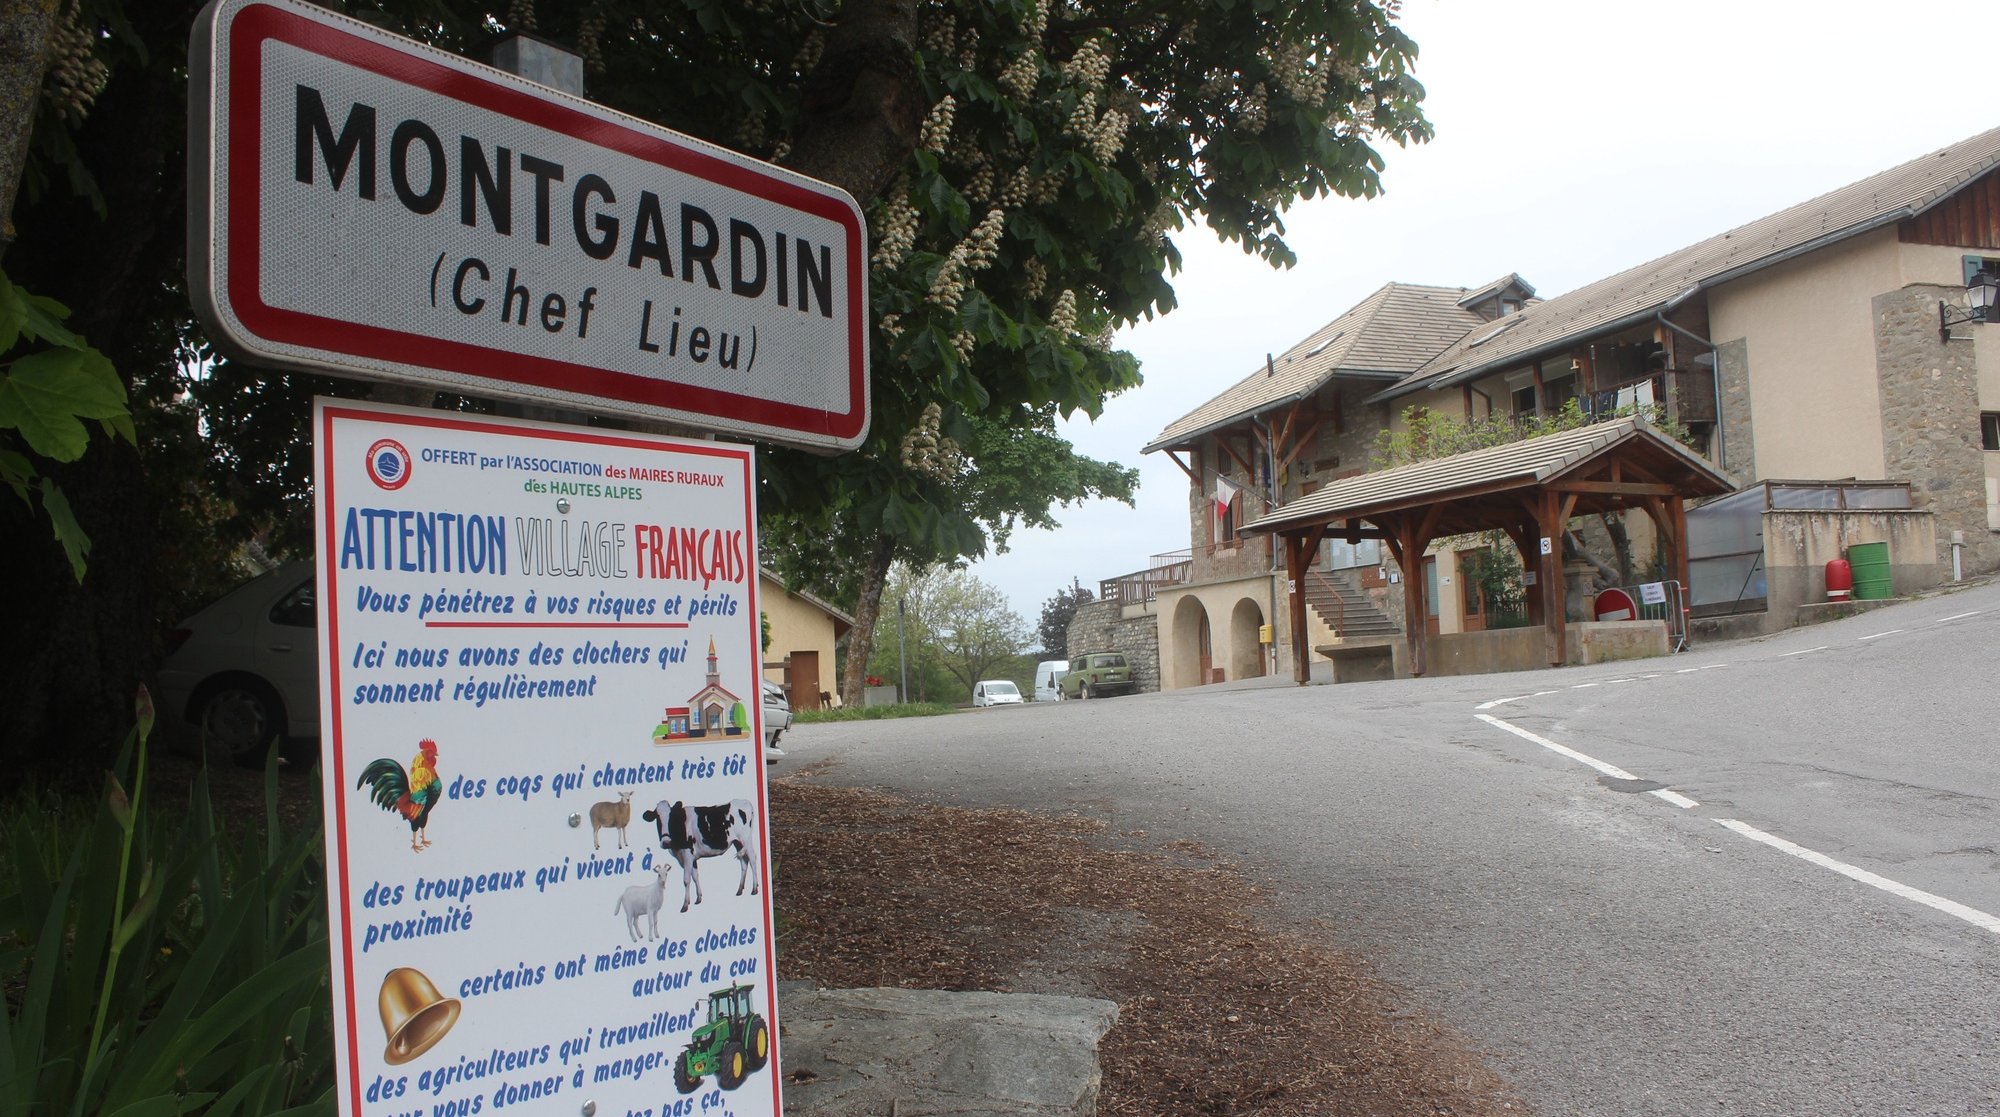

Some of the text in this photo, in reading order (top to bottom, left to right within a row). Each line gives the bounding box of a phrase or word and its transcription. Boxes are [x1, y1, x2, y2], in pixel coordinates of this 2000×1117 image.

[295, 83, 832, 318] MONTGARDIN
[429, 251, 757, 372] (Chef Lieu)
[422, 448, 723, 487] OFFERT par l'ASSOCIATION des MAIRES RURAUX
[524, 479, 642, 500] des HAUTES ALPES
[341, 507, 744, 591] ATTENTION VILLAGE FRANÇAIS
[357, 586, 737, 621] Vous pénétrez à vos risques et périls
[353, 640, 688, 670] Ici nous avons des clochers qui
[353, 673, 596, 708] sonnent régulièrement
[448, 754, 746, 800] des coqs qui chantent très tôt
[363, 848, 652, 908] des troupeaux qui vivent à
[363, 904, 472, 952] proximité
[460, 925, 756, 998] certains ont même des cloches
[633, 958, 757, 997] autour du cou
[366, 1009, 696, 1103] des agriculteurs qui travaillent
[433, 1051, 669, 1117] vous donner à manger.
[662, 1098, 693, 1117] pas
[701, 1087, 727, 1110] ça,
